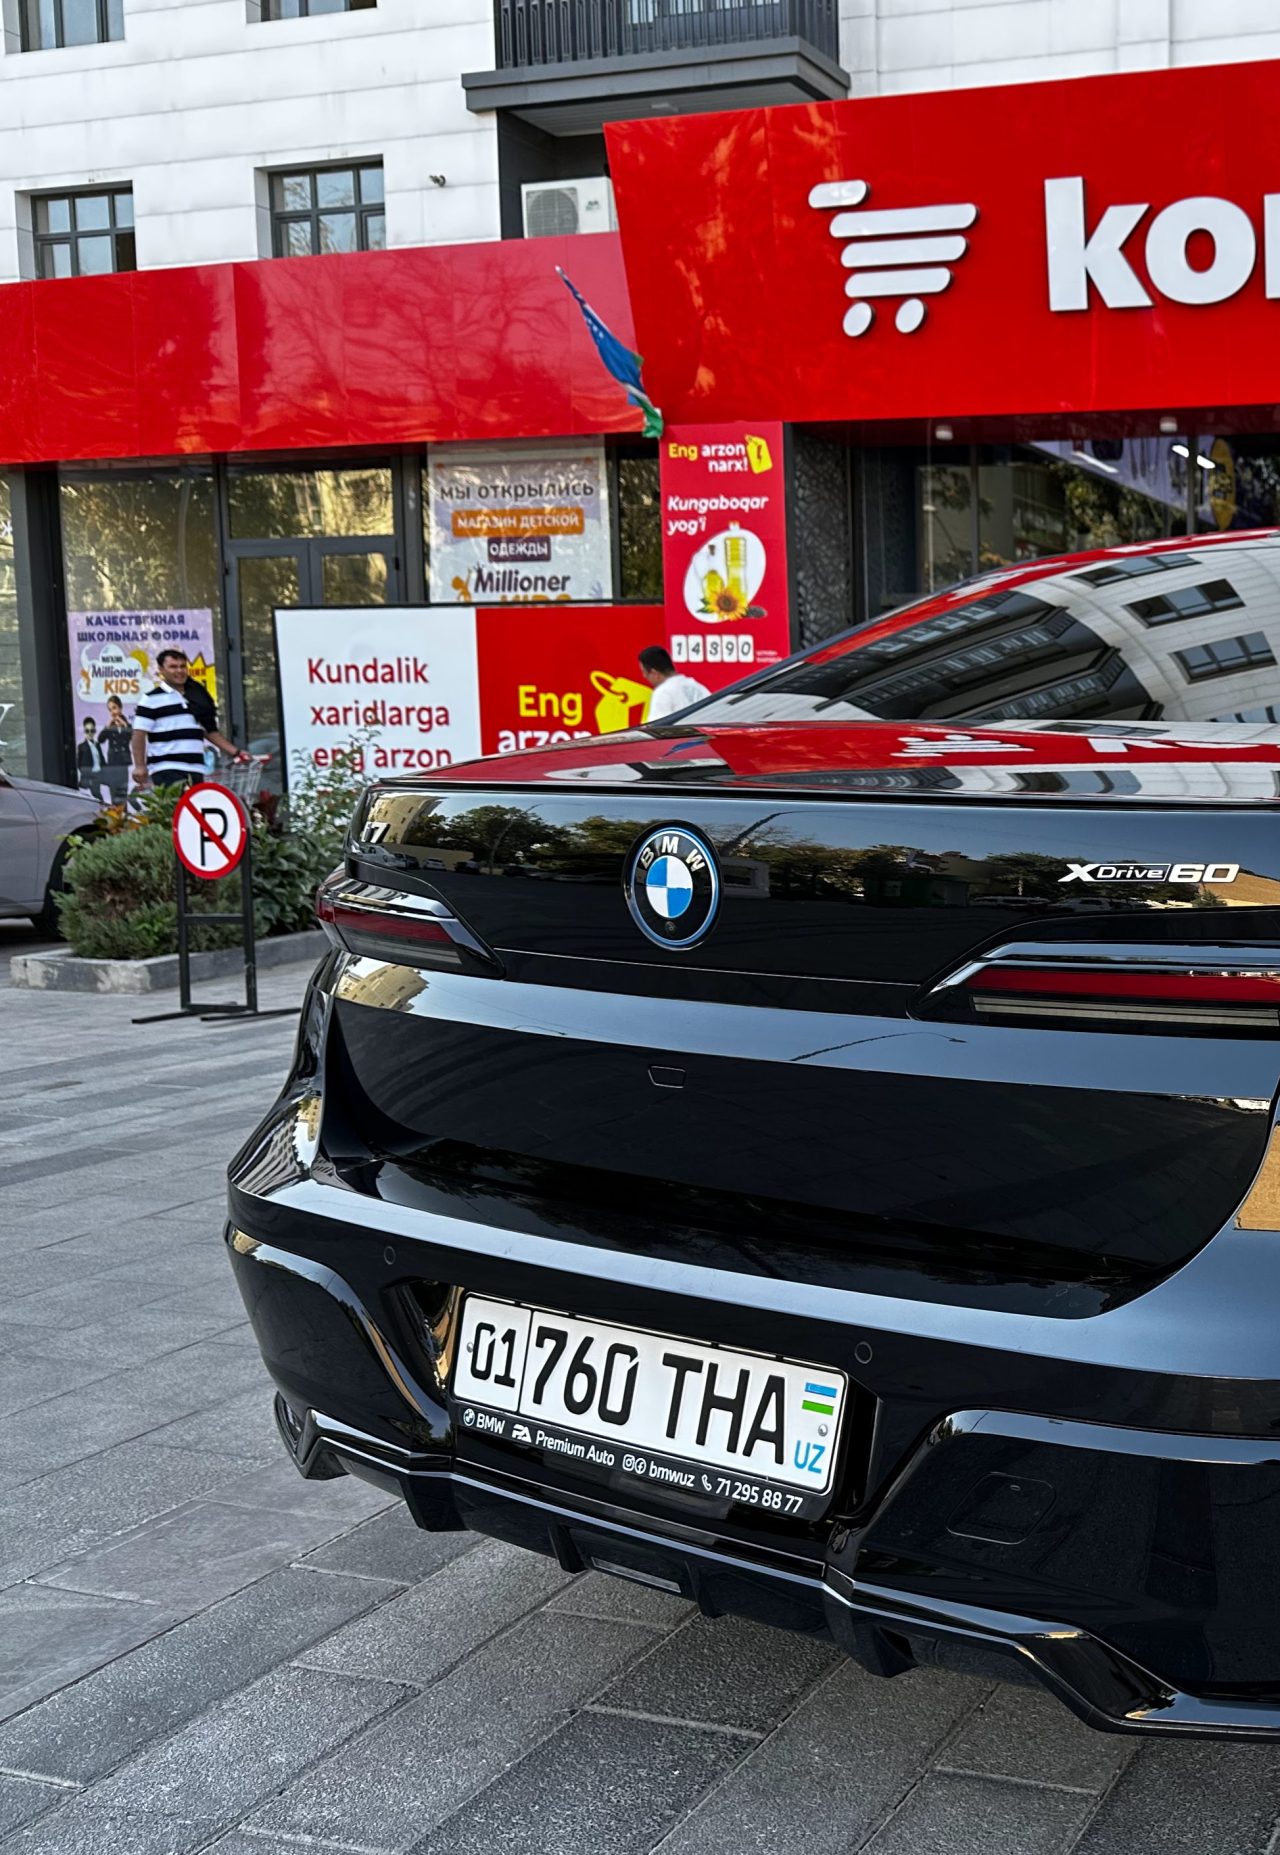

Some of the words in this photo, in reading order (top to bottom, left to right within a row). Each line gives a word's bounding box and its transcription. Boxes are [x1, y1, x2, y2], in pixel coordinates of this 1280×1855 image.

[668, 443, 698, 461] Eng
[702, 442, 745, 457] arzon
[708, 456, 748, 473] narx!
[667, 495, 769, 513] Kungaboqar
[520, 513, 579, 529] ДЕТСКОЙ
[489, 542, 548, 556] ОДЕЖДЫ
[474, 568, 571, 593] Millioner
[77, 631, 148, 643] ШКОЛЬНАЯ
[92, 664, 140, 678] Millioner
[308, 657, 429, 684] Kundalik
[104, 679, 140, 694] KIDS
[311, 699, 450, 732] xaridlarga
[518, 685, 582, 726] Eng
[374, 747, 452, 768] arzon
[640, 836, 705, 872] BMW
[470, 1321, 517, 1389] 01
[531, 1325, 640, 1426] 760
[662, 1352, 787, 1465] THA
[477, 1411, 506, 1435] BMW
[536, 1430, 585, 1458] Premium
[586, 1445, 615, 1466] Auto
[648, 1461, 695, 1487] bmwuz
[794, 1440, 826, 1474] UZ
